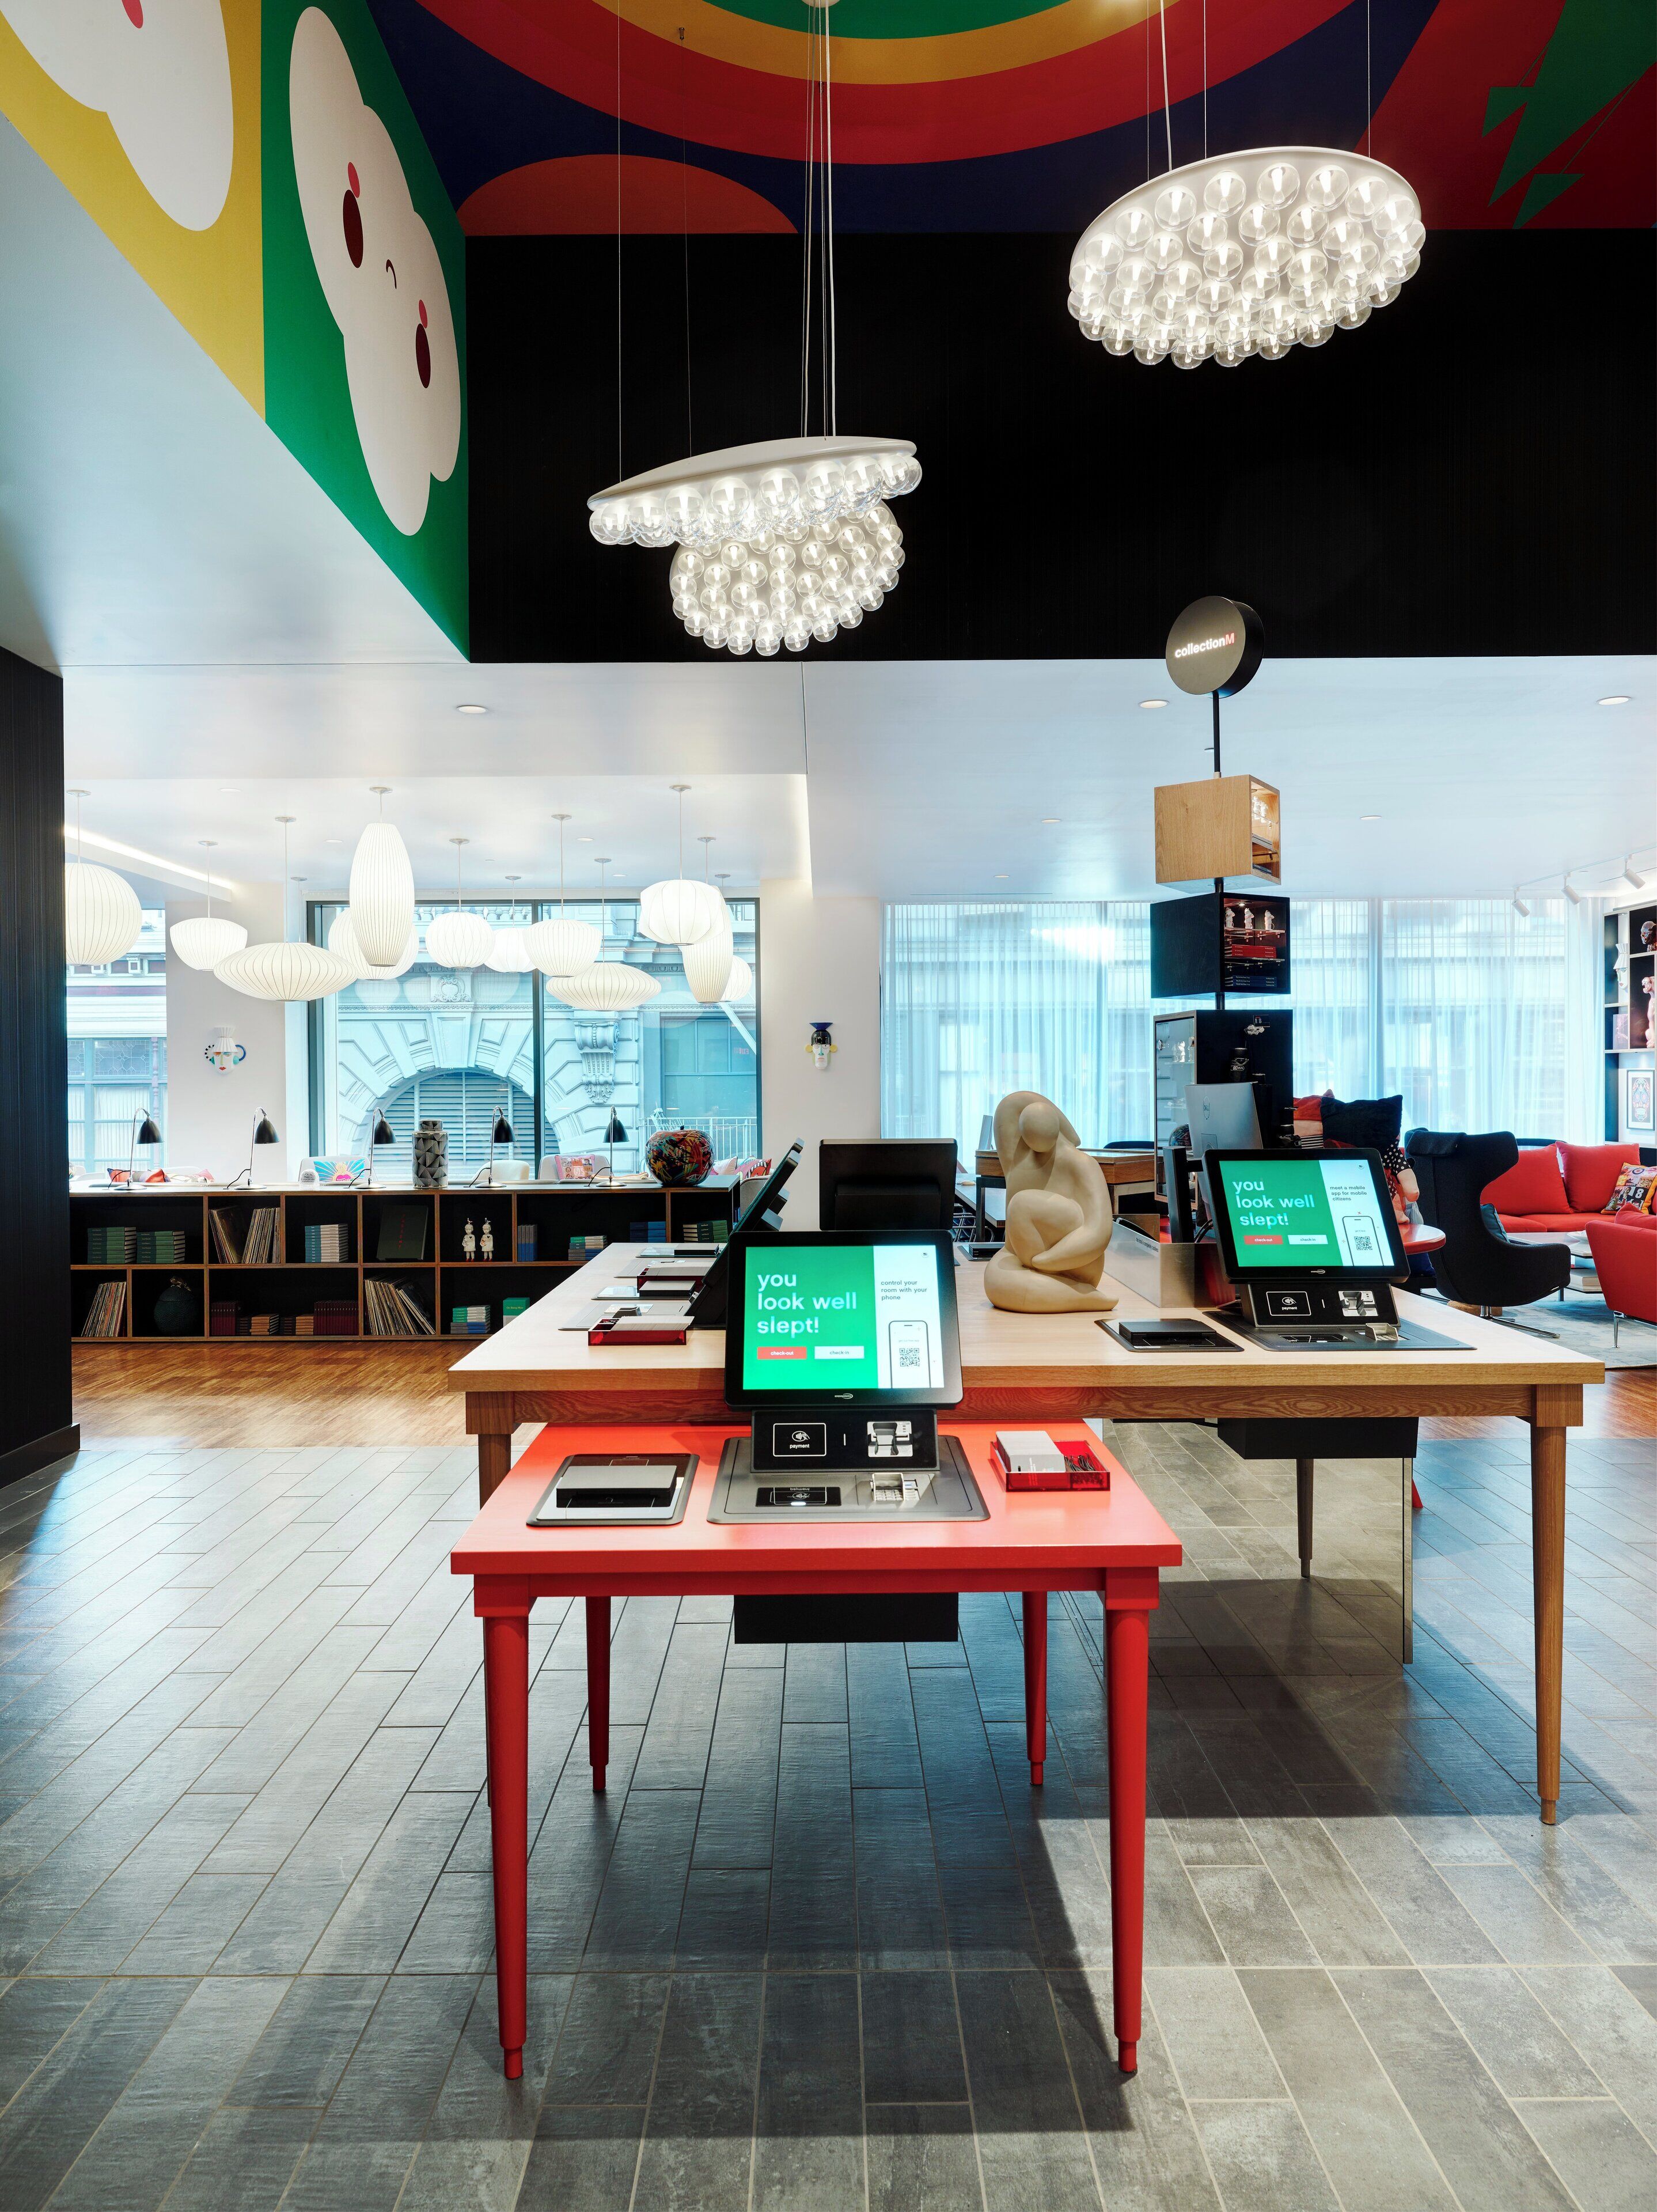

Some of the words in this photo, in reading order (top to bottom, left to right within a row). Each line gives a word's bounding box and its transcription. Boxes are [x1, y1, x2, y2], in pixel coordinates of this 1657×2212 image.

[1174, 632, 1235, 658] collectionM
[1232, 1181, 1264, 1195] you
[1235, 1195, 1275, 1209] look
[1279, 1194, 1315, 1208] well
[1239, 1212, 1289, 1230] slept!
[757, 1274, 797, 1292] you
[758, 1292, 805, 1310] look
[812, 1291, 856, 1309] well
[757, 1316, 819, 1339] slept!
